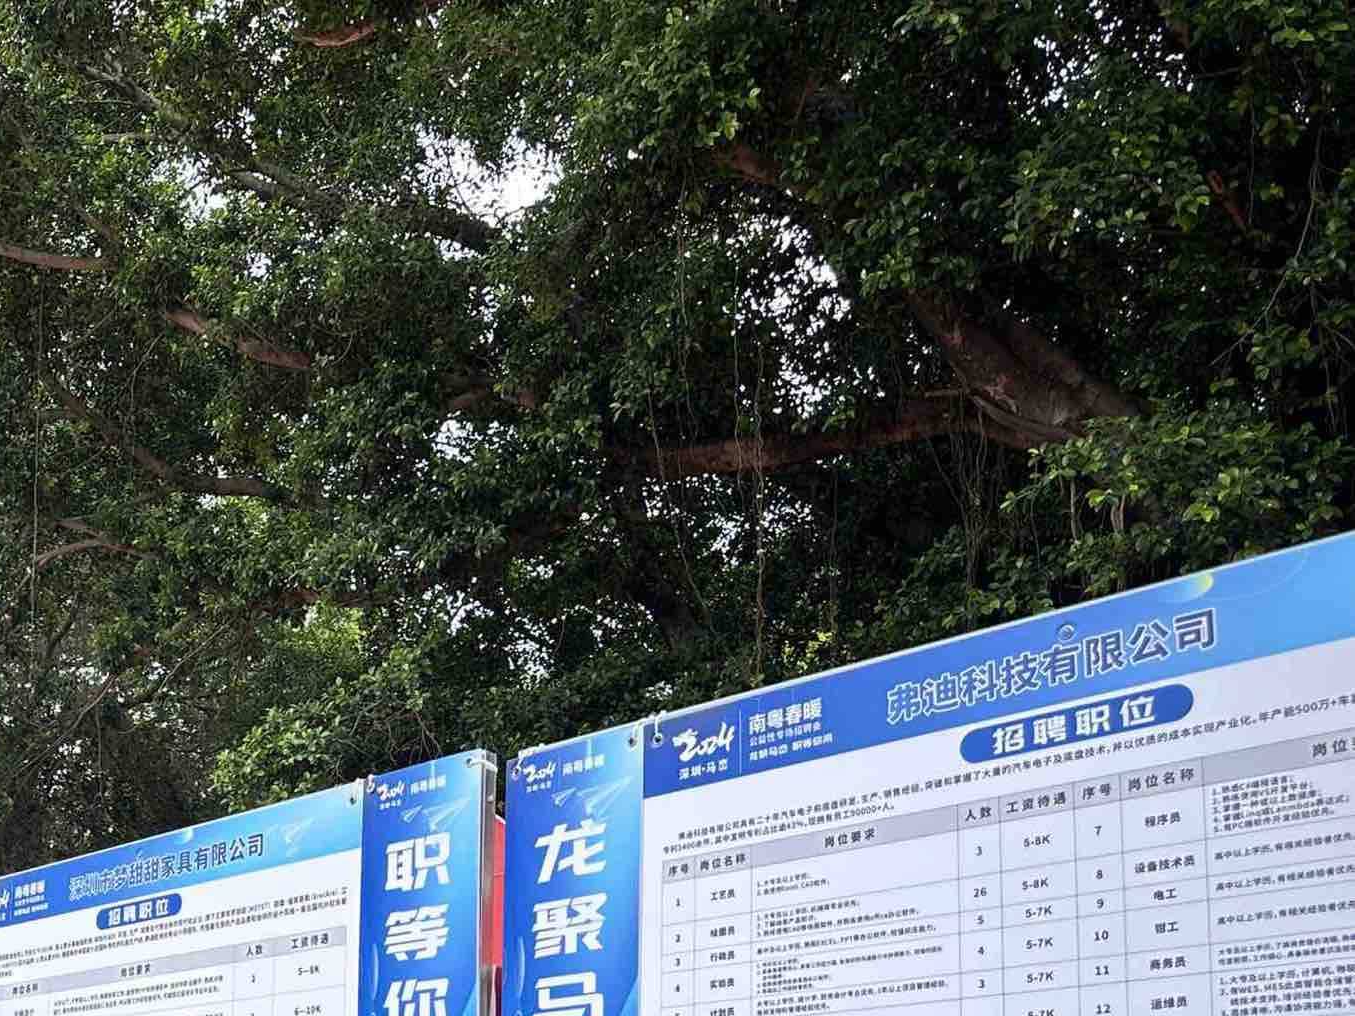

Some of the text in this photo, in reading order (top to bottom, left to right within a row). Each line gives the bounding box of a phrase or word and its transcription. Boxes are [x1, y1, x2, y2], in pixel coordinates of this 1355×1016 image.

[886, 608, 1216, 725] 弗迪科技有限公司
[749, 698, 823, 735] 南粤春暖
[992, 696, 1156, 755] 招聘职位
[1128, 767, 1195, 793] 岗位名称
[1082, 783, 1113, 801] 序号
[1005, 791, 1067, 814] 工资待遇
[964, 806, 993, 822] 人数
[1144, 812, 1182, 828] 程序员
[1094, 825, 1102, 836] 7
[824, 828, 877, 849] 岗位要求
[1023, 833, 1052, 847] 5-8K
[68, 832, 265, 903] 深圳市梦甜甜家具有限公司
[699, 853, 747, 871] 岗位名称
[1134, 855, 1196, 875] 设备技术员
[668, 863, 690, 877] 序号
[1096, 869, 1104, 880] 8
[1021, 877, 1049, 891] 5-8K
[710, 888, 736, 901] 工艺员
[973, 887, 988, 898] 26
[1153, 888, 1177, 902] 电工
[1025, 904, 1053, 919] 5-7K
[1096, 899, 1105, 910] 9
[107, 897, 172, 928] 招聘职位
[977, 915, 985, 926] 5
[1025, 936, 1054, 951] 5-7K
[1094, 930, 1110, 942] 10
[977, 945, 986, 956] 4
[1095, 965, 1111, 976] 11
[1149, 955, 1187, 972] 商务员
[977, 979, 986, 989] 3
[1027, 970, 1055, 984] 5-7K
[1096, 1003, 1111, 1015] 12
[1150, 995, 1188, 1011] 运维员
